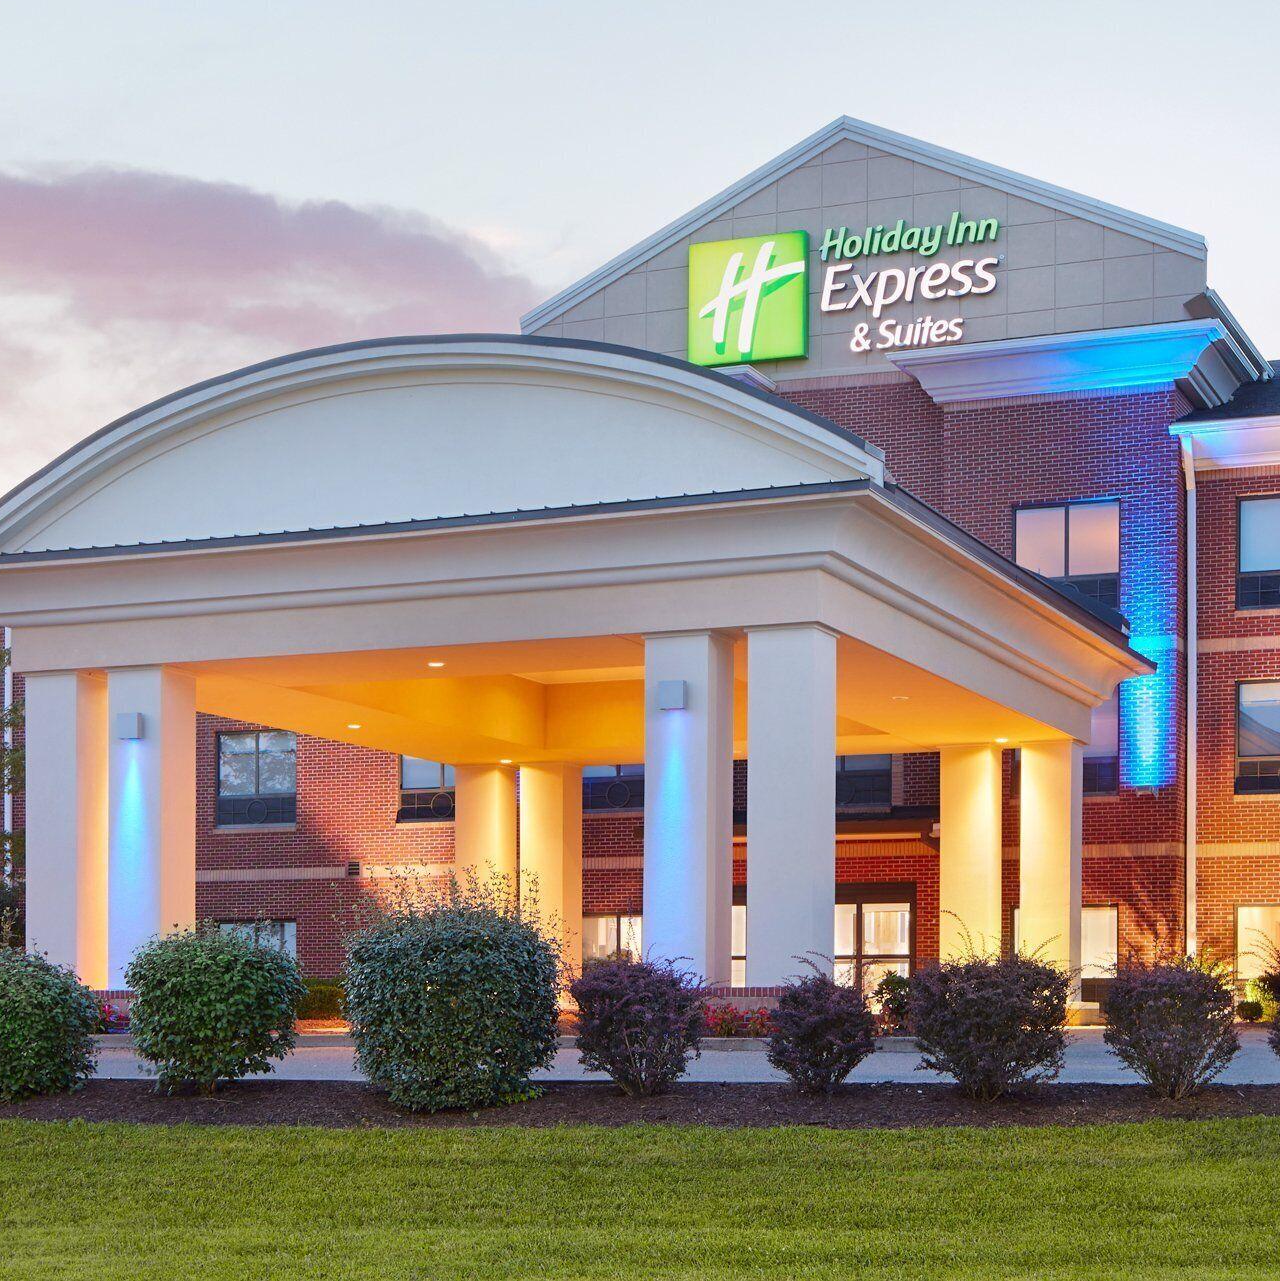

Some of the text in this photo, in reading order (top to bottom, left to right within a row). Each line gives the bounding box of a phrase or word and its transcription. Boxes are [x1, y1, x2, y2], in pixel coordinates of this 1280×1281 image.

[819, 211, 998, 261] Holiday Inn
[820, 257, 999, 318] Express
[849, 316, 963, 352] & Suites
